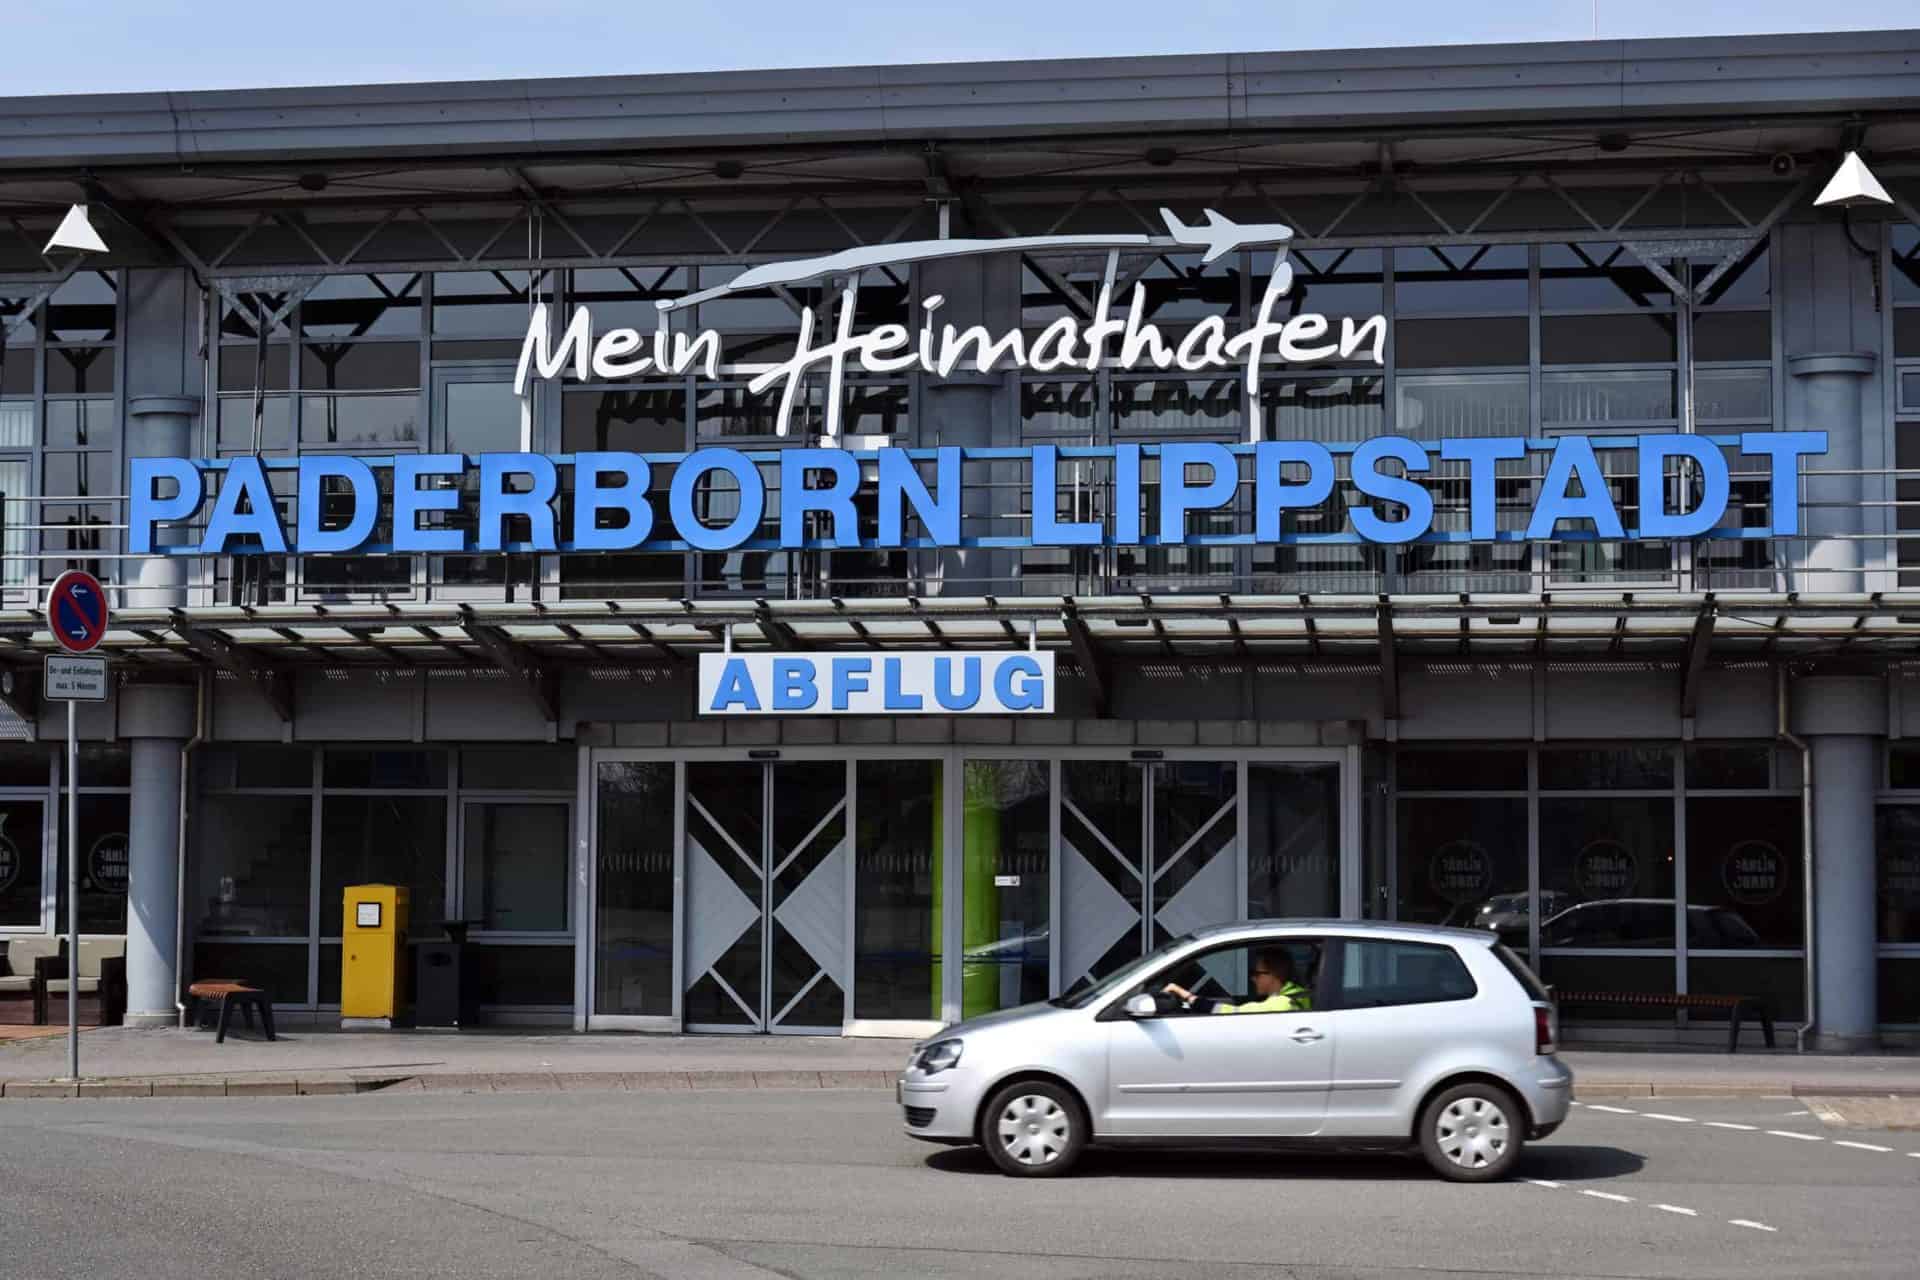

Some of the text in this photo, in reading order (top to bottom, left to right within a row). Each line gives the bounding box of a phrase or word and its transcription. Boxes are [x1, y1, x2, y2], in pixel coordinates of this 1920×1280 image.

[514, 262, 1388, 437] Mein Heimathafen
[128, 431, 1828, 553] PADERBORN LIPPSTADT
[710, 655, 1045, 711] ABFLUG
